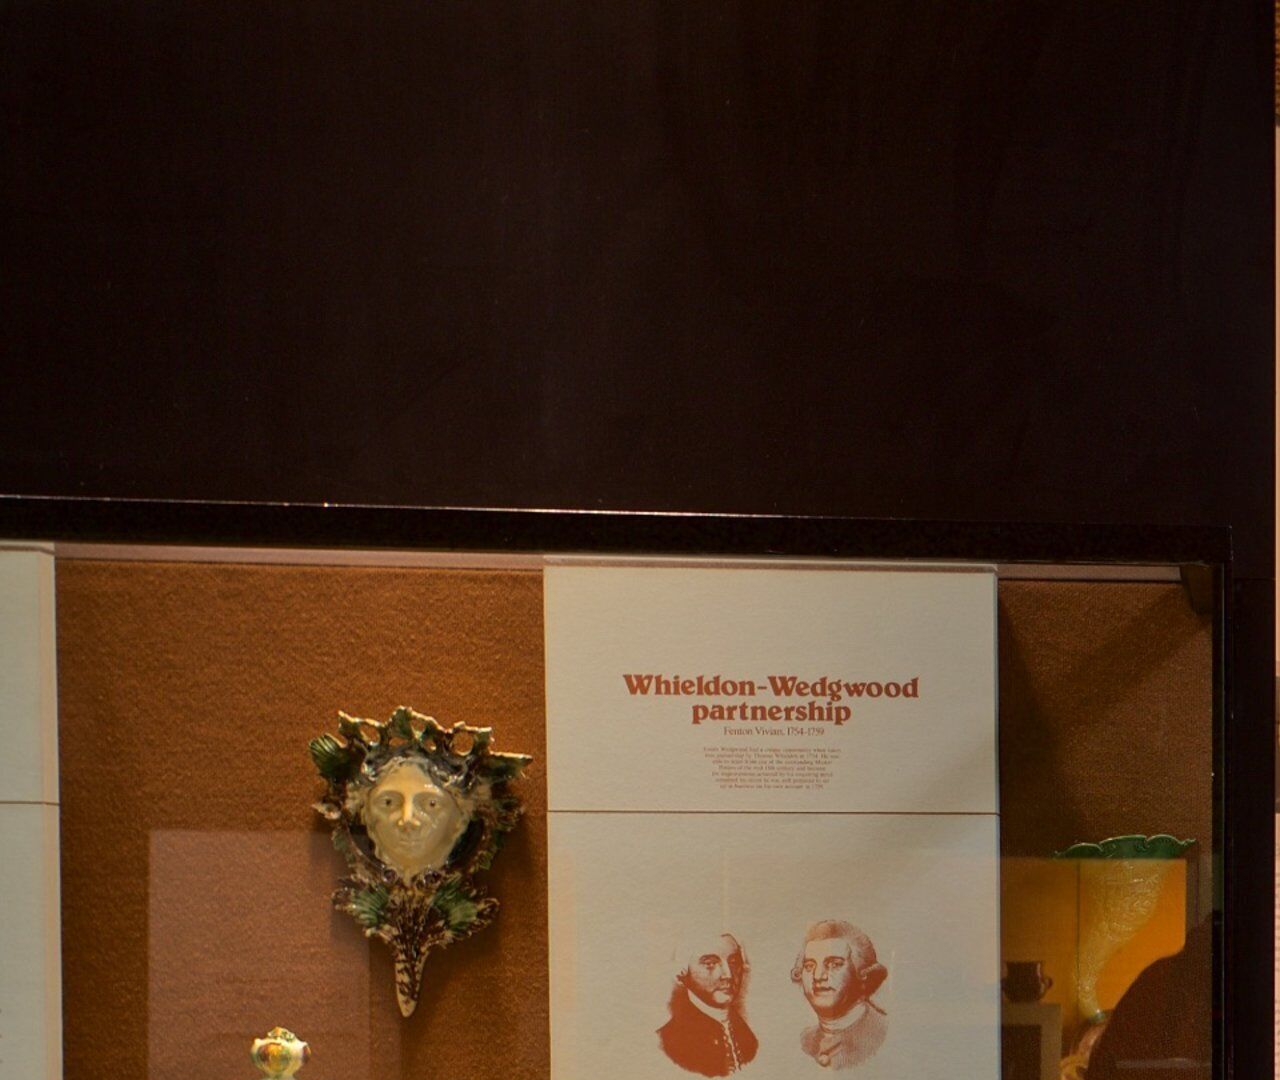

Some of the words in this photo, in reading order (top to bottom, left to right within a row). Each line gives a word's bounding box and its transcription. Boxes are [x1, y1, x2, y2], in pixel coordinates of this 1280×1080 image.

[624, 674, 919, 701] Whieldon-Wedgwood
[691, 700, 852, 725] partnership
[723, 727, 753, 736] Fenton
